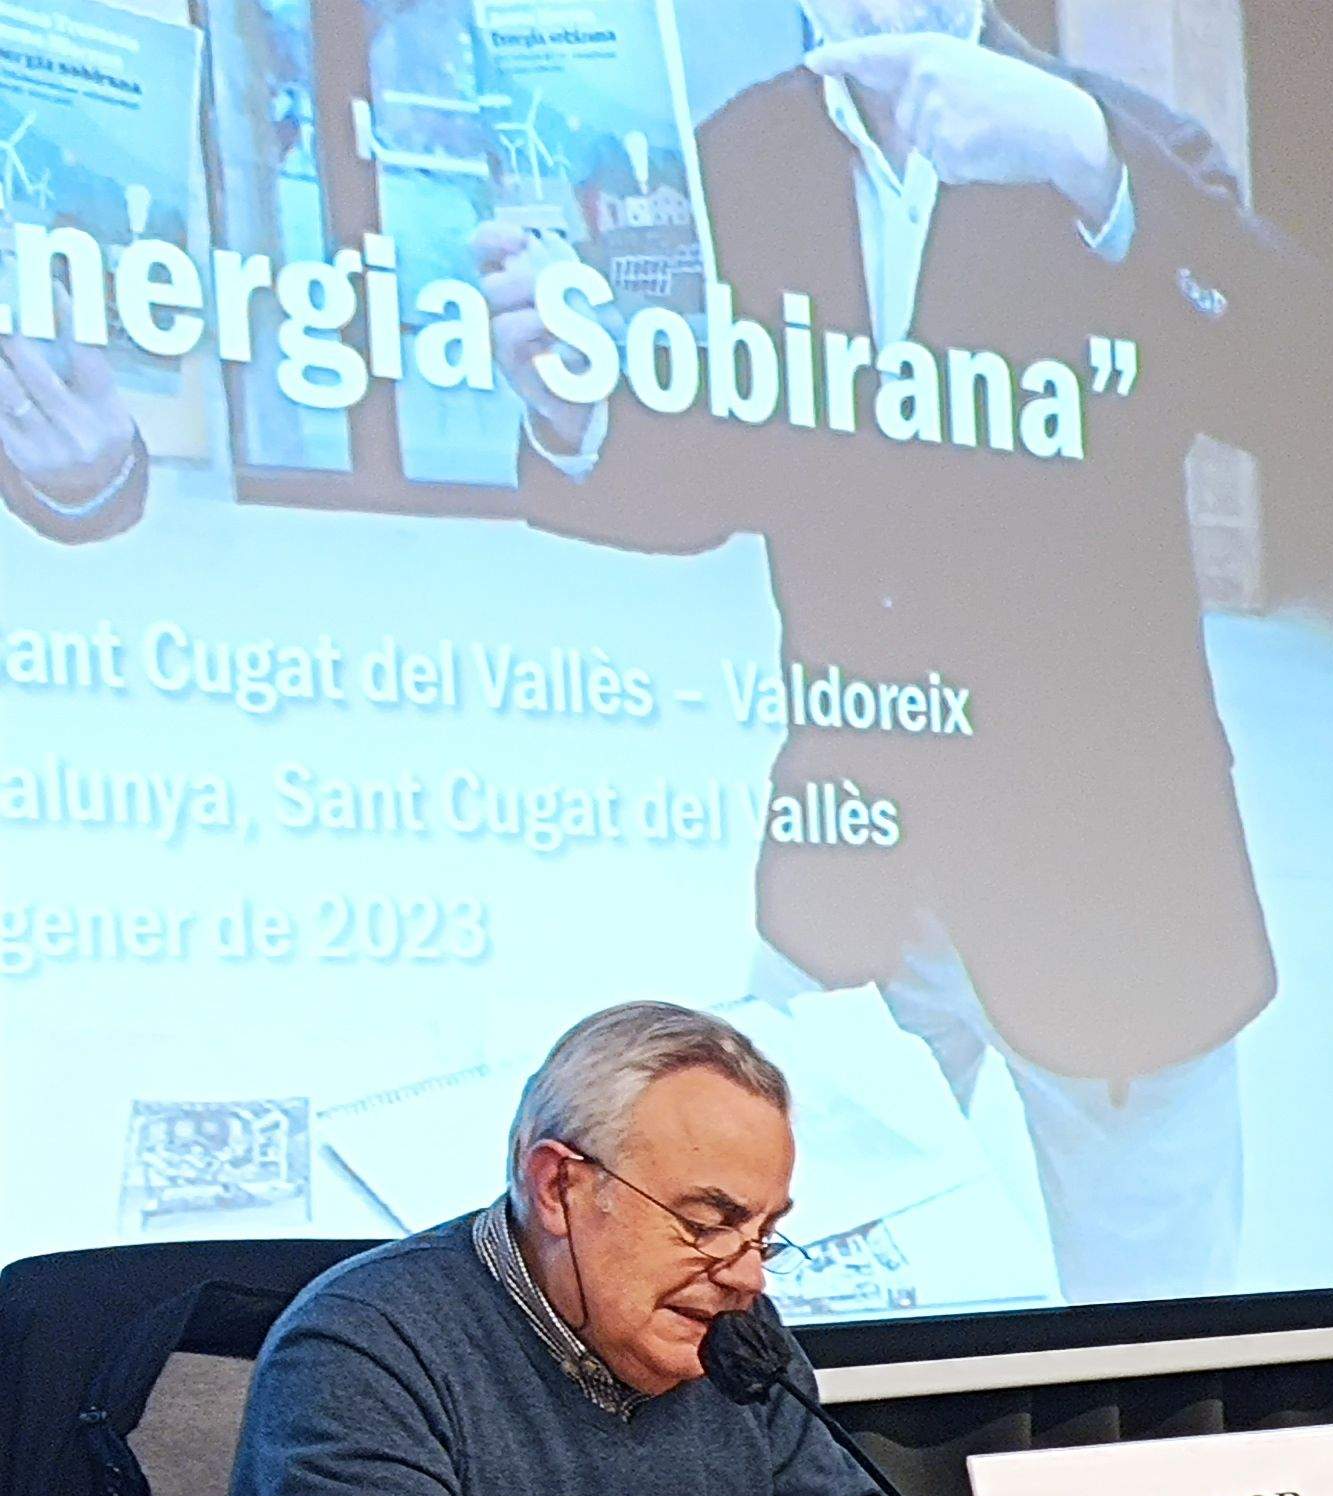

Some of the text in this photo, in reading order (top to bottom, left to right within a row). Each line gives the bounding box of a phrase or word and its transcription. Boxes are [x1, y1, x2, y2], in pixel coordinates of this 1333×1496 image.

[0, 222, 1138, 460] nergia Sobirana”
[3, 618, 126, 689] ant
[144, 621, 343, 714] Cugat
[361, 633, 457, 706] del
[471, 642, 653, 718] Vallès
[721, 658, 974, 736] Valdoreix
[272, 761, 426, 833] Sant
[443, 768, 620, 853] Cugat
[639, 775, 723, 841] del
[738, 777, 902, 848] Vallès
[0, 893, 489, 976] gener de 2023
